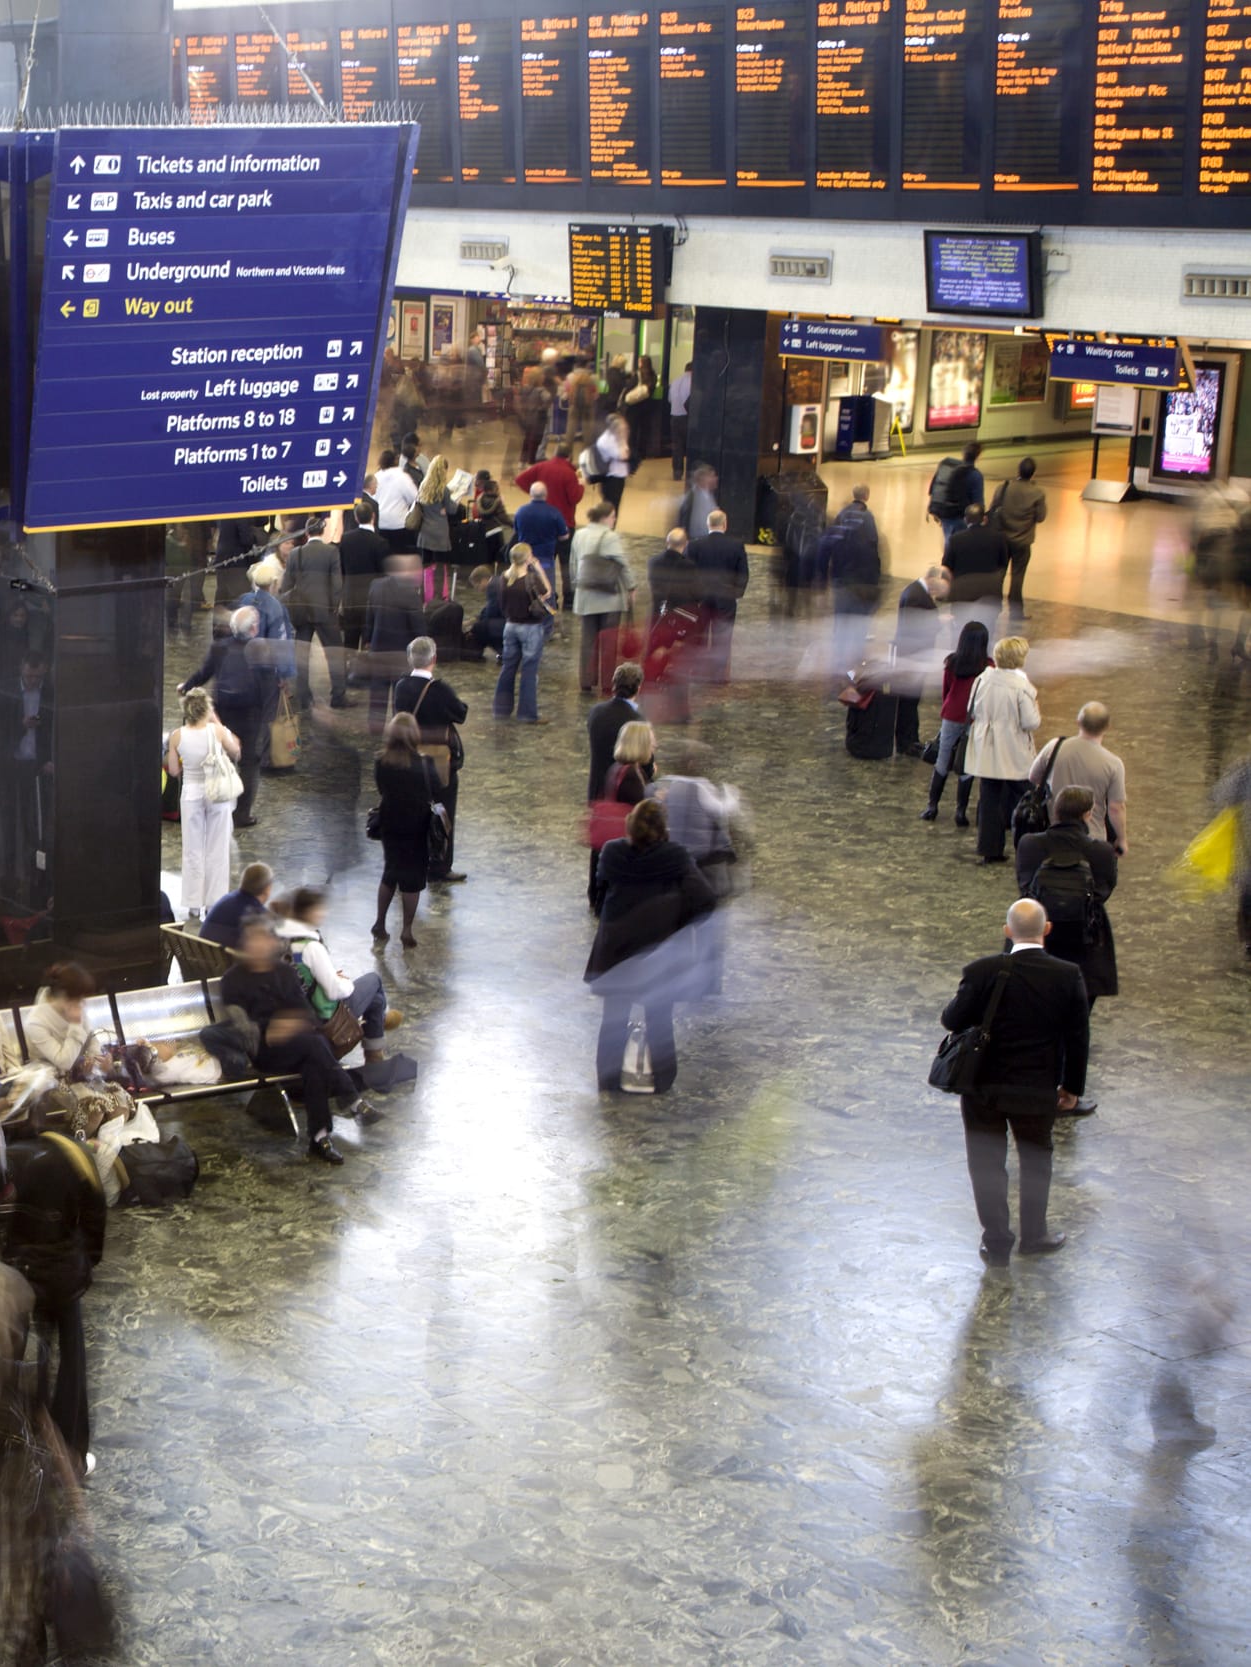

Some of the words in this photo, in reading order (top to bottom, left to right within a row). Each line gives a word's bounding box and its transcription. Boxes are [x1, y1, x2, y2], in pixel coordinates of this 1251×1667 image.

[136, 156, 193, 174] Tickets
[197, 156, 226, 173] and
[230, 155, 320, 172] information
[134, 191, 173, 210] Taxis
[176, 191, 206, 208] and
[209, 194, 234, 208] car
[237, 190, 272, 211] park
[128, 228, 175, 246] Buses
[127, 260, 230, 283] Underground
[236, 266, 274, 277] Northern
[276, 266, 291, 275] and
[293, 265, 325, 275] Victoria
[326, 264, 345, 275] lines
[125, 298, 158, 318] Way
[164, 297, 193, 314] out
[807, 325, 828, 334] Station
[829, 327, 858, 336] reception
[171, 347, 227, 365] Station
[231, 344, 302, 364] reception
[806, 340, 818, 349] Left
[819, 341, 843, 352] luggage
[1085, 346, 1112, 359] Waiting
[1114, 350, 1134, 358] room
[1115, 365, 1139, 376] Toilets
[141, 390, 159, 400] Lost
[161, 388, 198, 401] property
[205, 379, 236, 397] Left
[240, 378, 299, 398] luggage
[167, 413, 240, 432] Platforms
[243, 411, 255, 426] 8
[258, 411, 275, 426] to
[279, 409, 295, 425] 18
[174, 447, 247, 465] Platforms
[251, 444, 257, 460] 1
[261, 444, 278, 459] to
[281, 441, 292, 458] 7
[240, 476, 288, 493] Toilets
